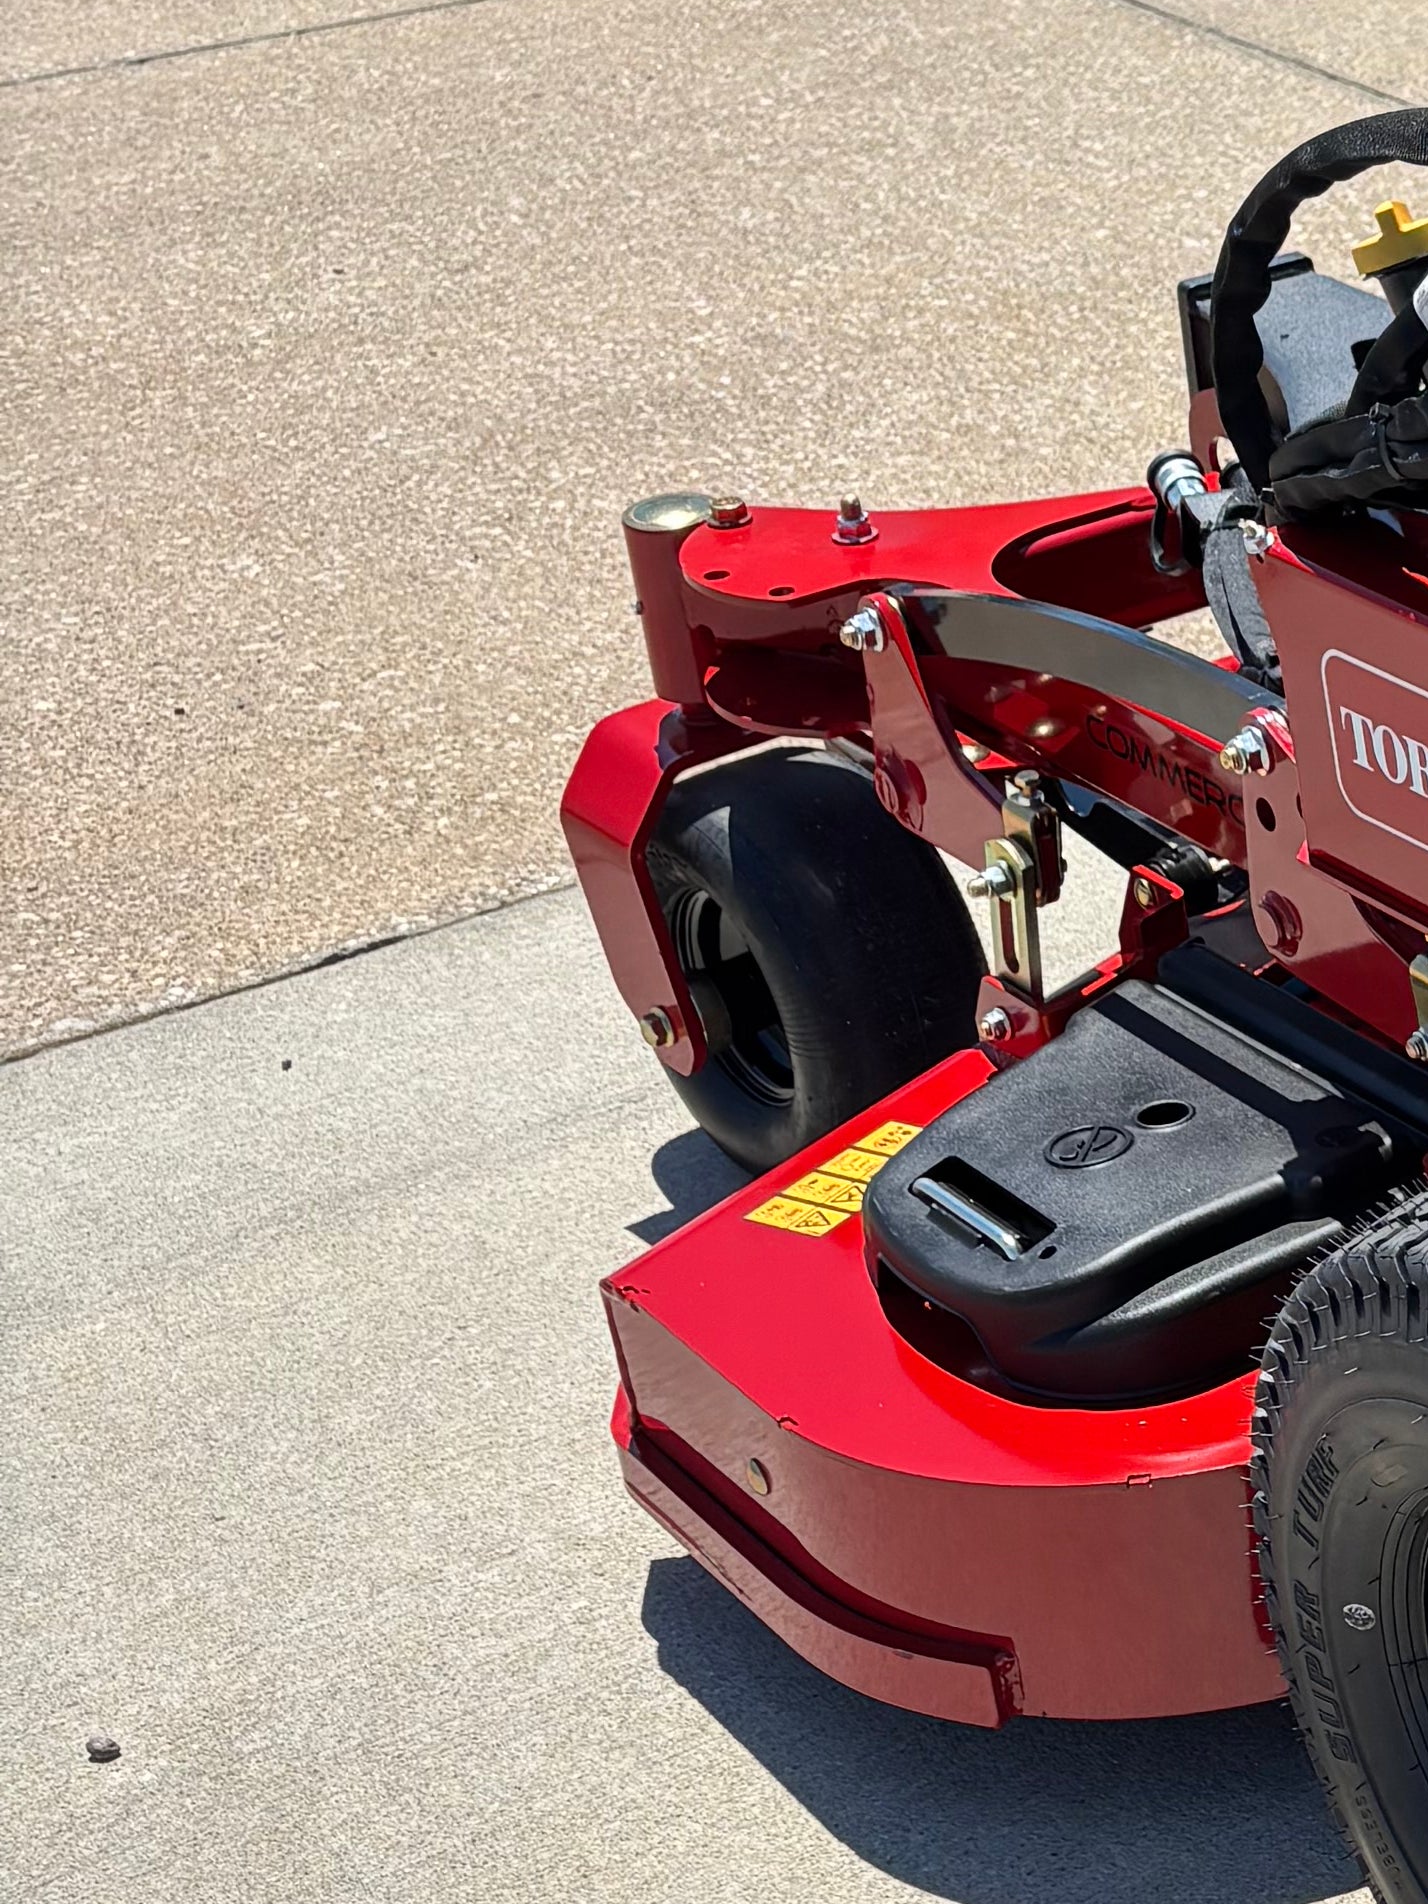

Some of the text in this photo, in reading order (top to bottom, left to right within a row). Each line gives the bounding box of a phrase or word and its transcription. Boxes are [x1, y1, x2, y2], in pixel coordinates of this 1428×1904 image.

[1293, 1439, 1358, 1764] SUPER TURF
[1355, 1795, 1402, 1891] UBELESS
